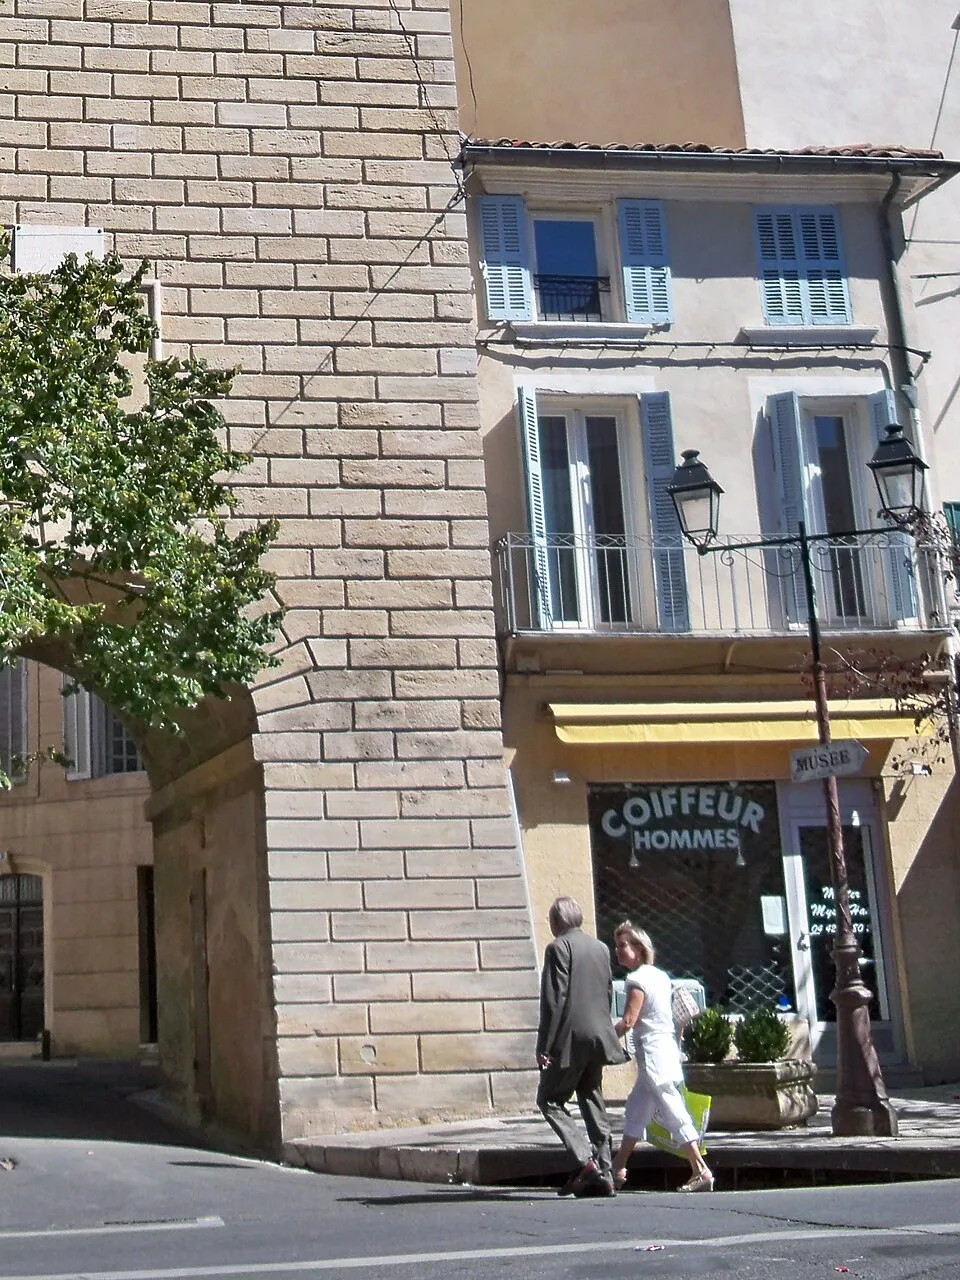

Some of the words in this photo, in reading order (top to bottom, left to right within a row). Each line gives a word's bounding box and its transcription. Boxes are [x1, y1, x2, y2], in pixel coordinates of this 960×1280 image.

[601, 787, 765, 837] COIFFEUR
[634, 828, 739, 850] HOMMES
[825, 924, 837, 933] 42
